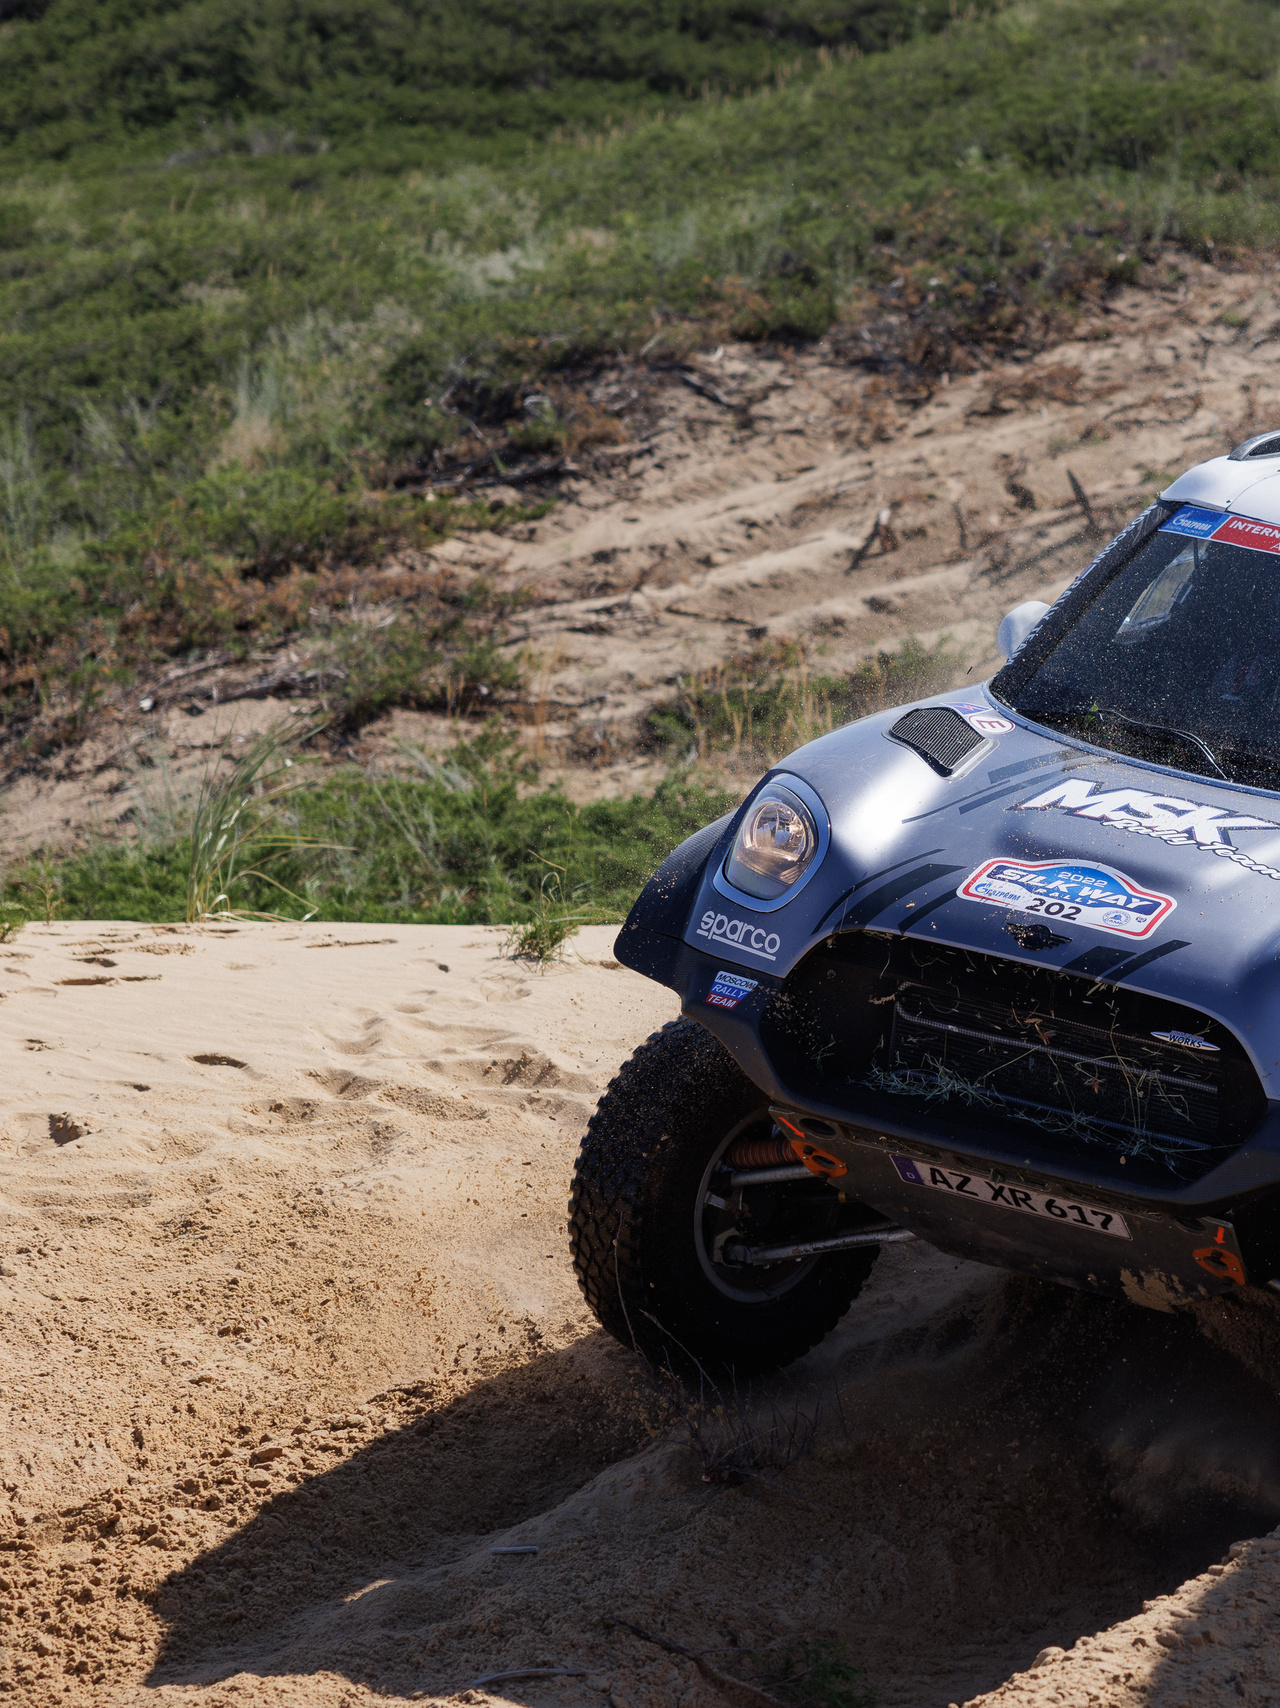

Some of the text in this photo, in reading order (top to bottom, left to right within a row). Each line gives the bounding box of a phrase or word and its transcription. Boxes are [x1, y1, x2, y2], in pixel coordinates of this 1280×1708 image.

[1101, 818, 1197, 846] Rally
[1000, 868, 1154, 909] SILK WAY
[1057, 871, 1108, 888] 2022
[1025, 897, 1082, 921] 202
[699, 910, 781, 956] sparco
[712, 984, 747, 998] RALLY
[716, 973, 757, 990] MOSCOW
[707, 994, 737, 1008] TEAM
[1168, 1034, 1203, 1048] WORKS
[929, 1167, 1114, 1231] AZ XR 617
